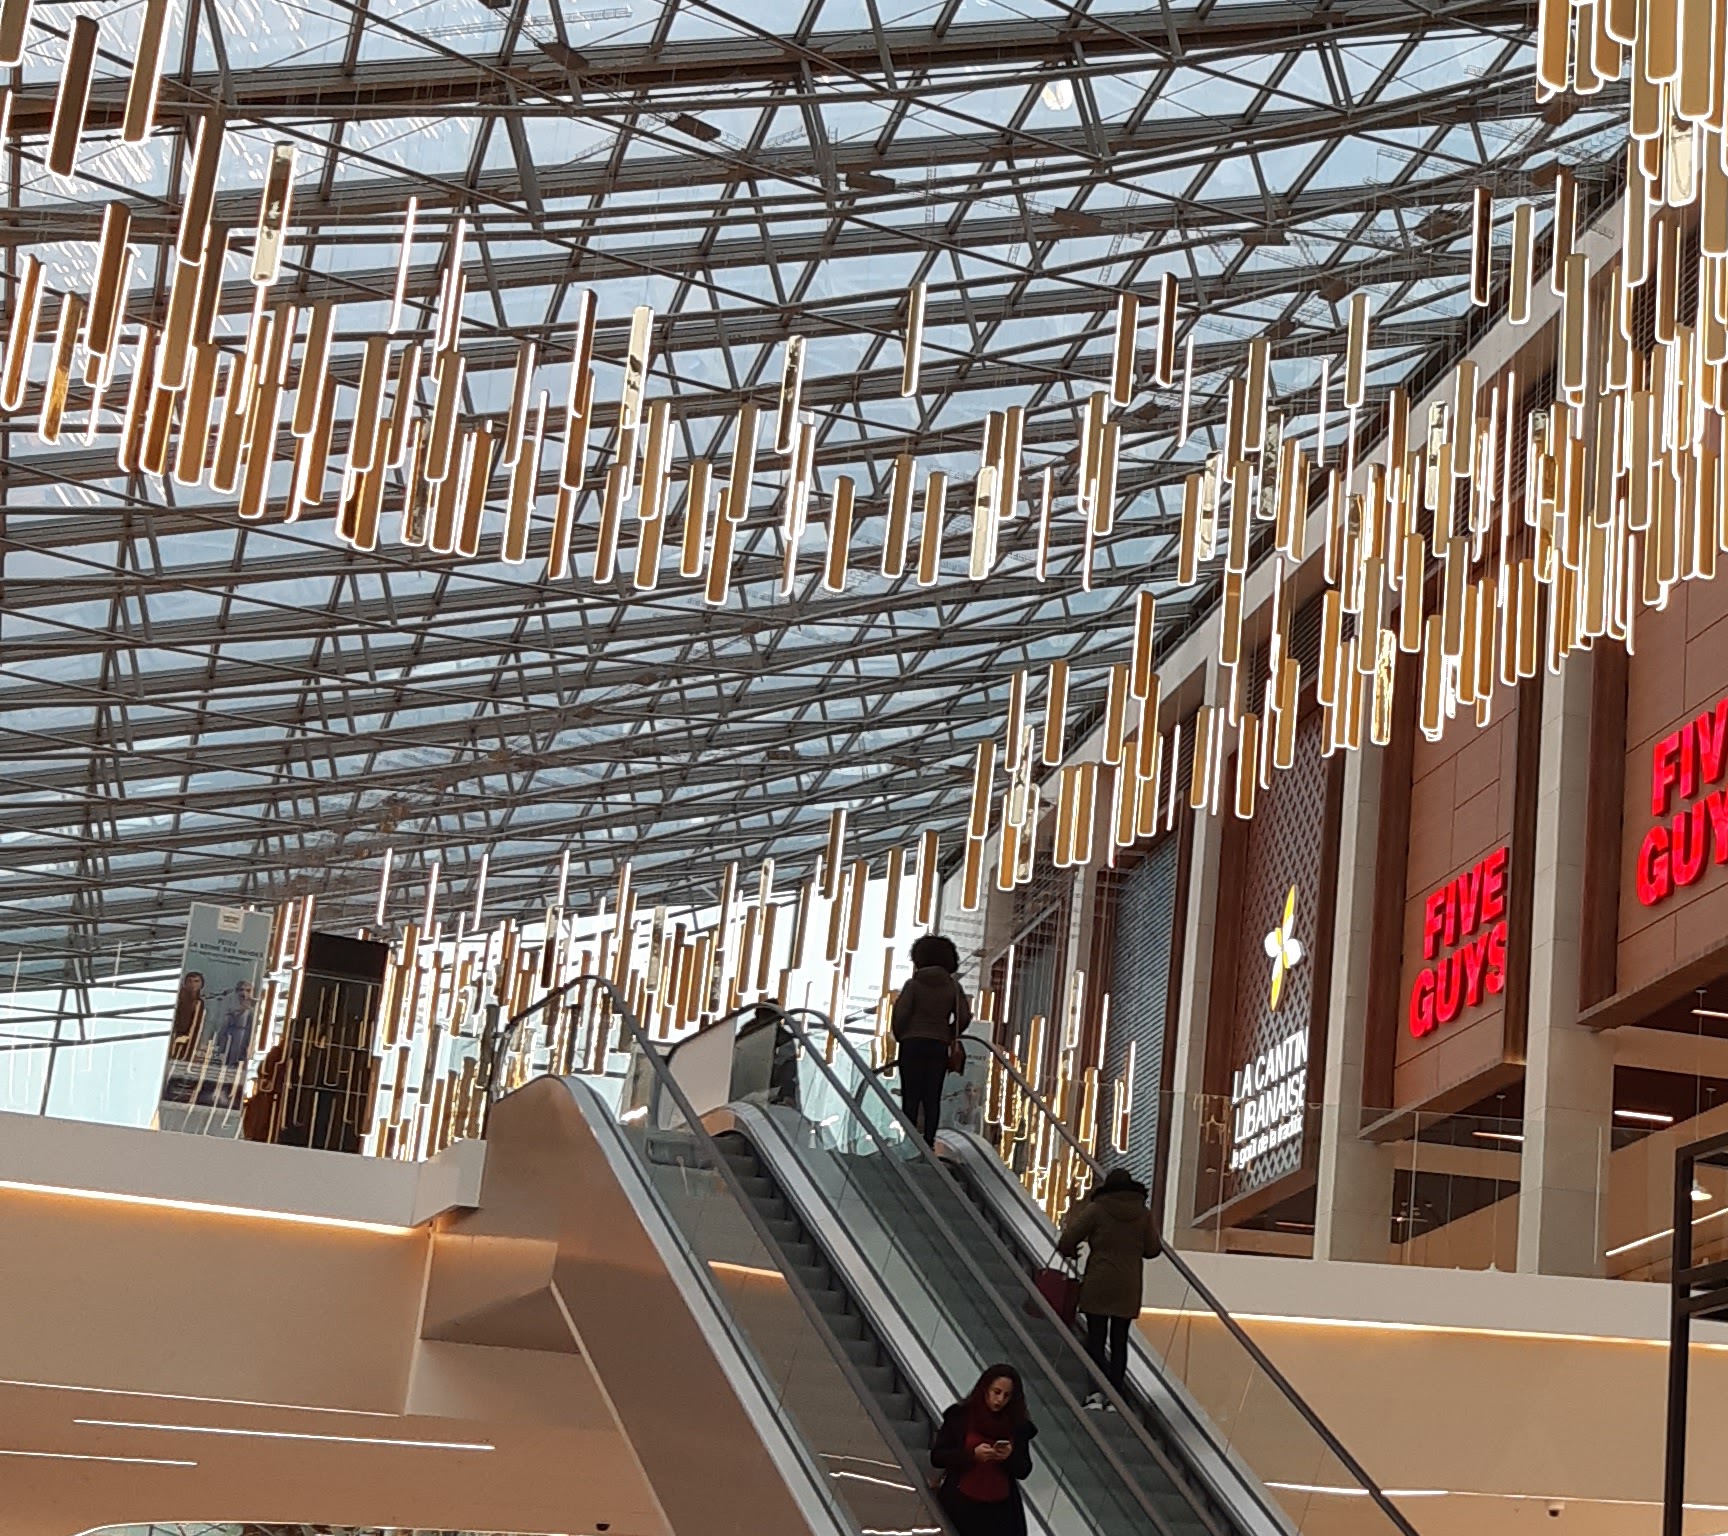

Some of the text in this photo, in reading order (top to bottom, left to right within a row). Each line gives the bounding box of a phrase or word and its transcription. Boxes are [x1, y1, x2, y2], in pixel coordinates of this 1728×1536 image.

[1424, 847, 1508, 959] FIVE
[1409, 920, 1507, 1039] GUYS
[1232, 1063, 1252, 1104] LA
